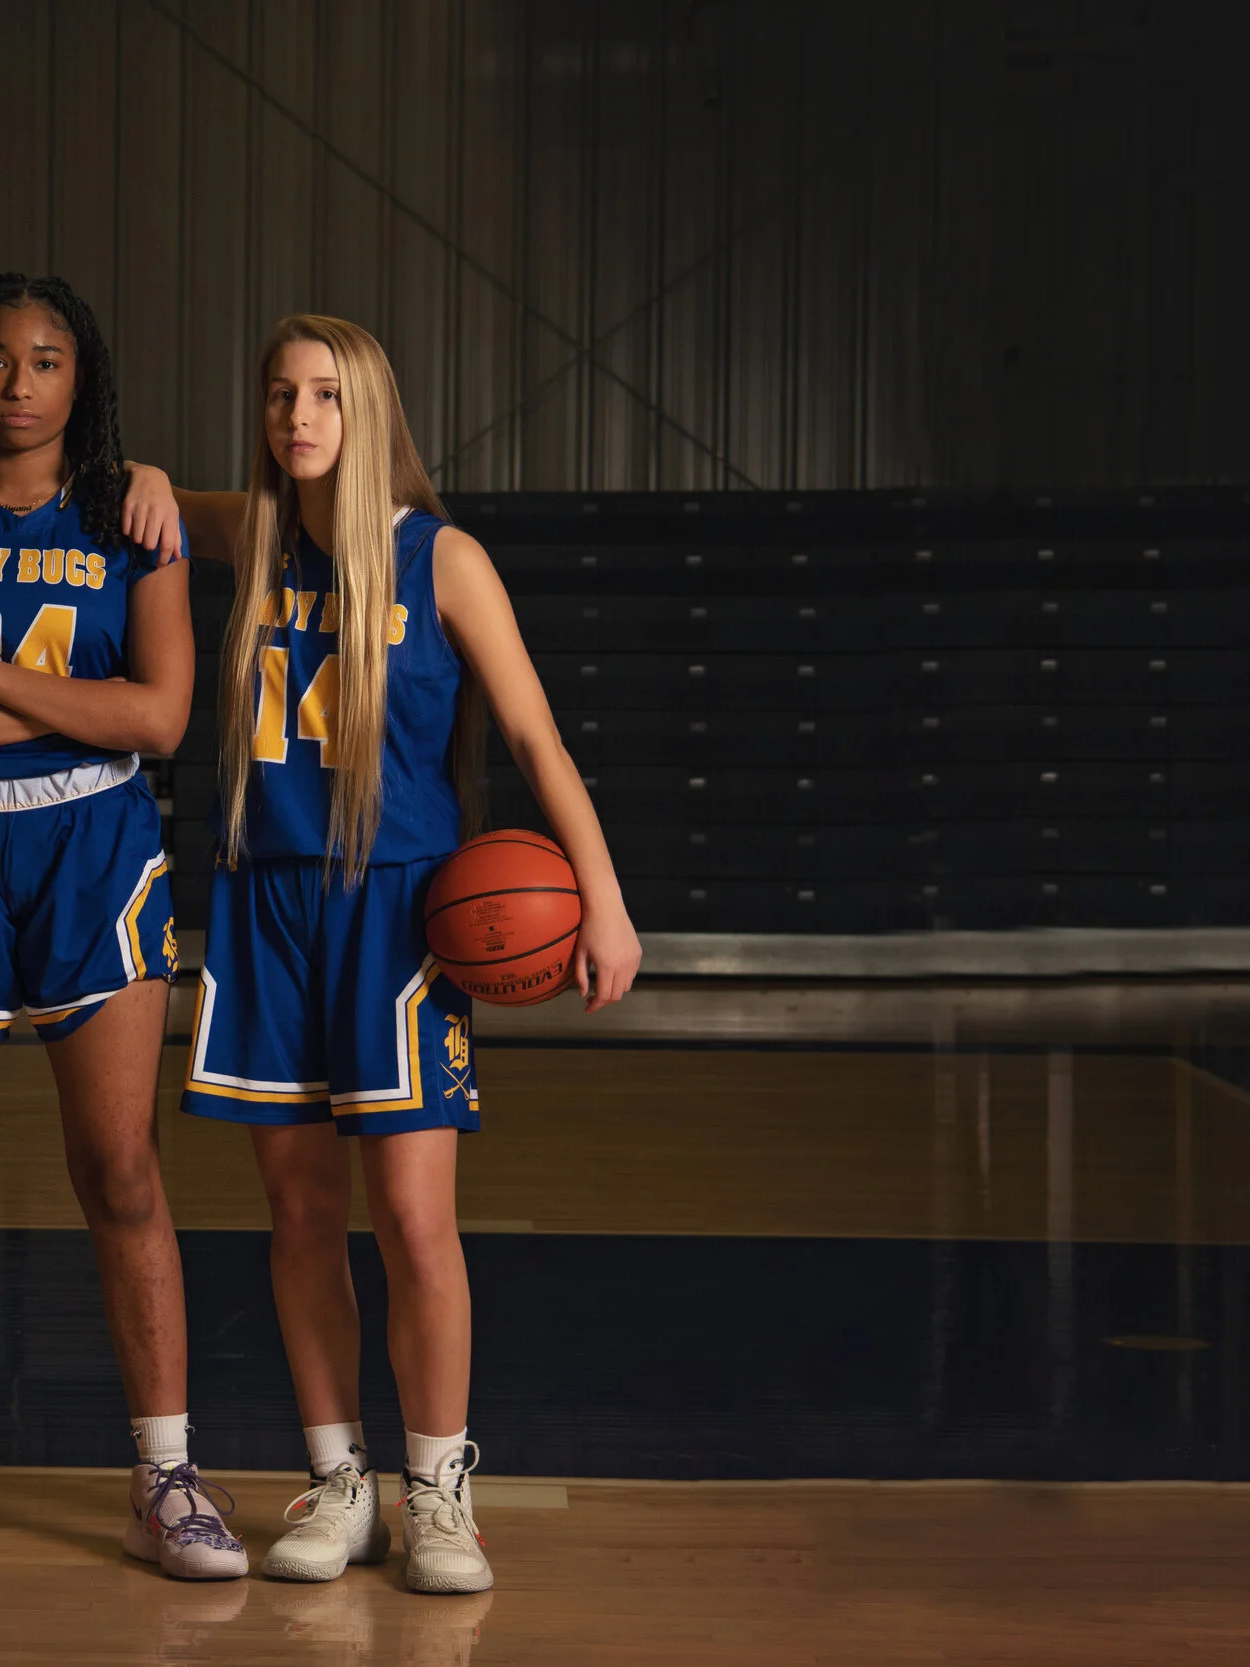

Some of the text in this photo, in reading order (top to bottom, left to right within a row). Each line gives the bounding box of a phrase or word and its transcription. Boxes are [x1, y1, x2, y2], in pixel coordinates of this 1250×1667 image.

[17, 547, 107, 590] BUCS
[258, 587, 409, 645] ADY BS
[251, 645, 346, 769] 14
